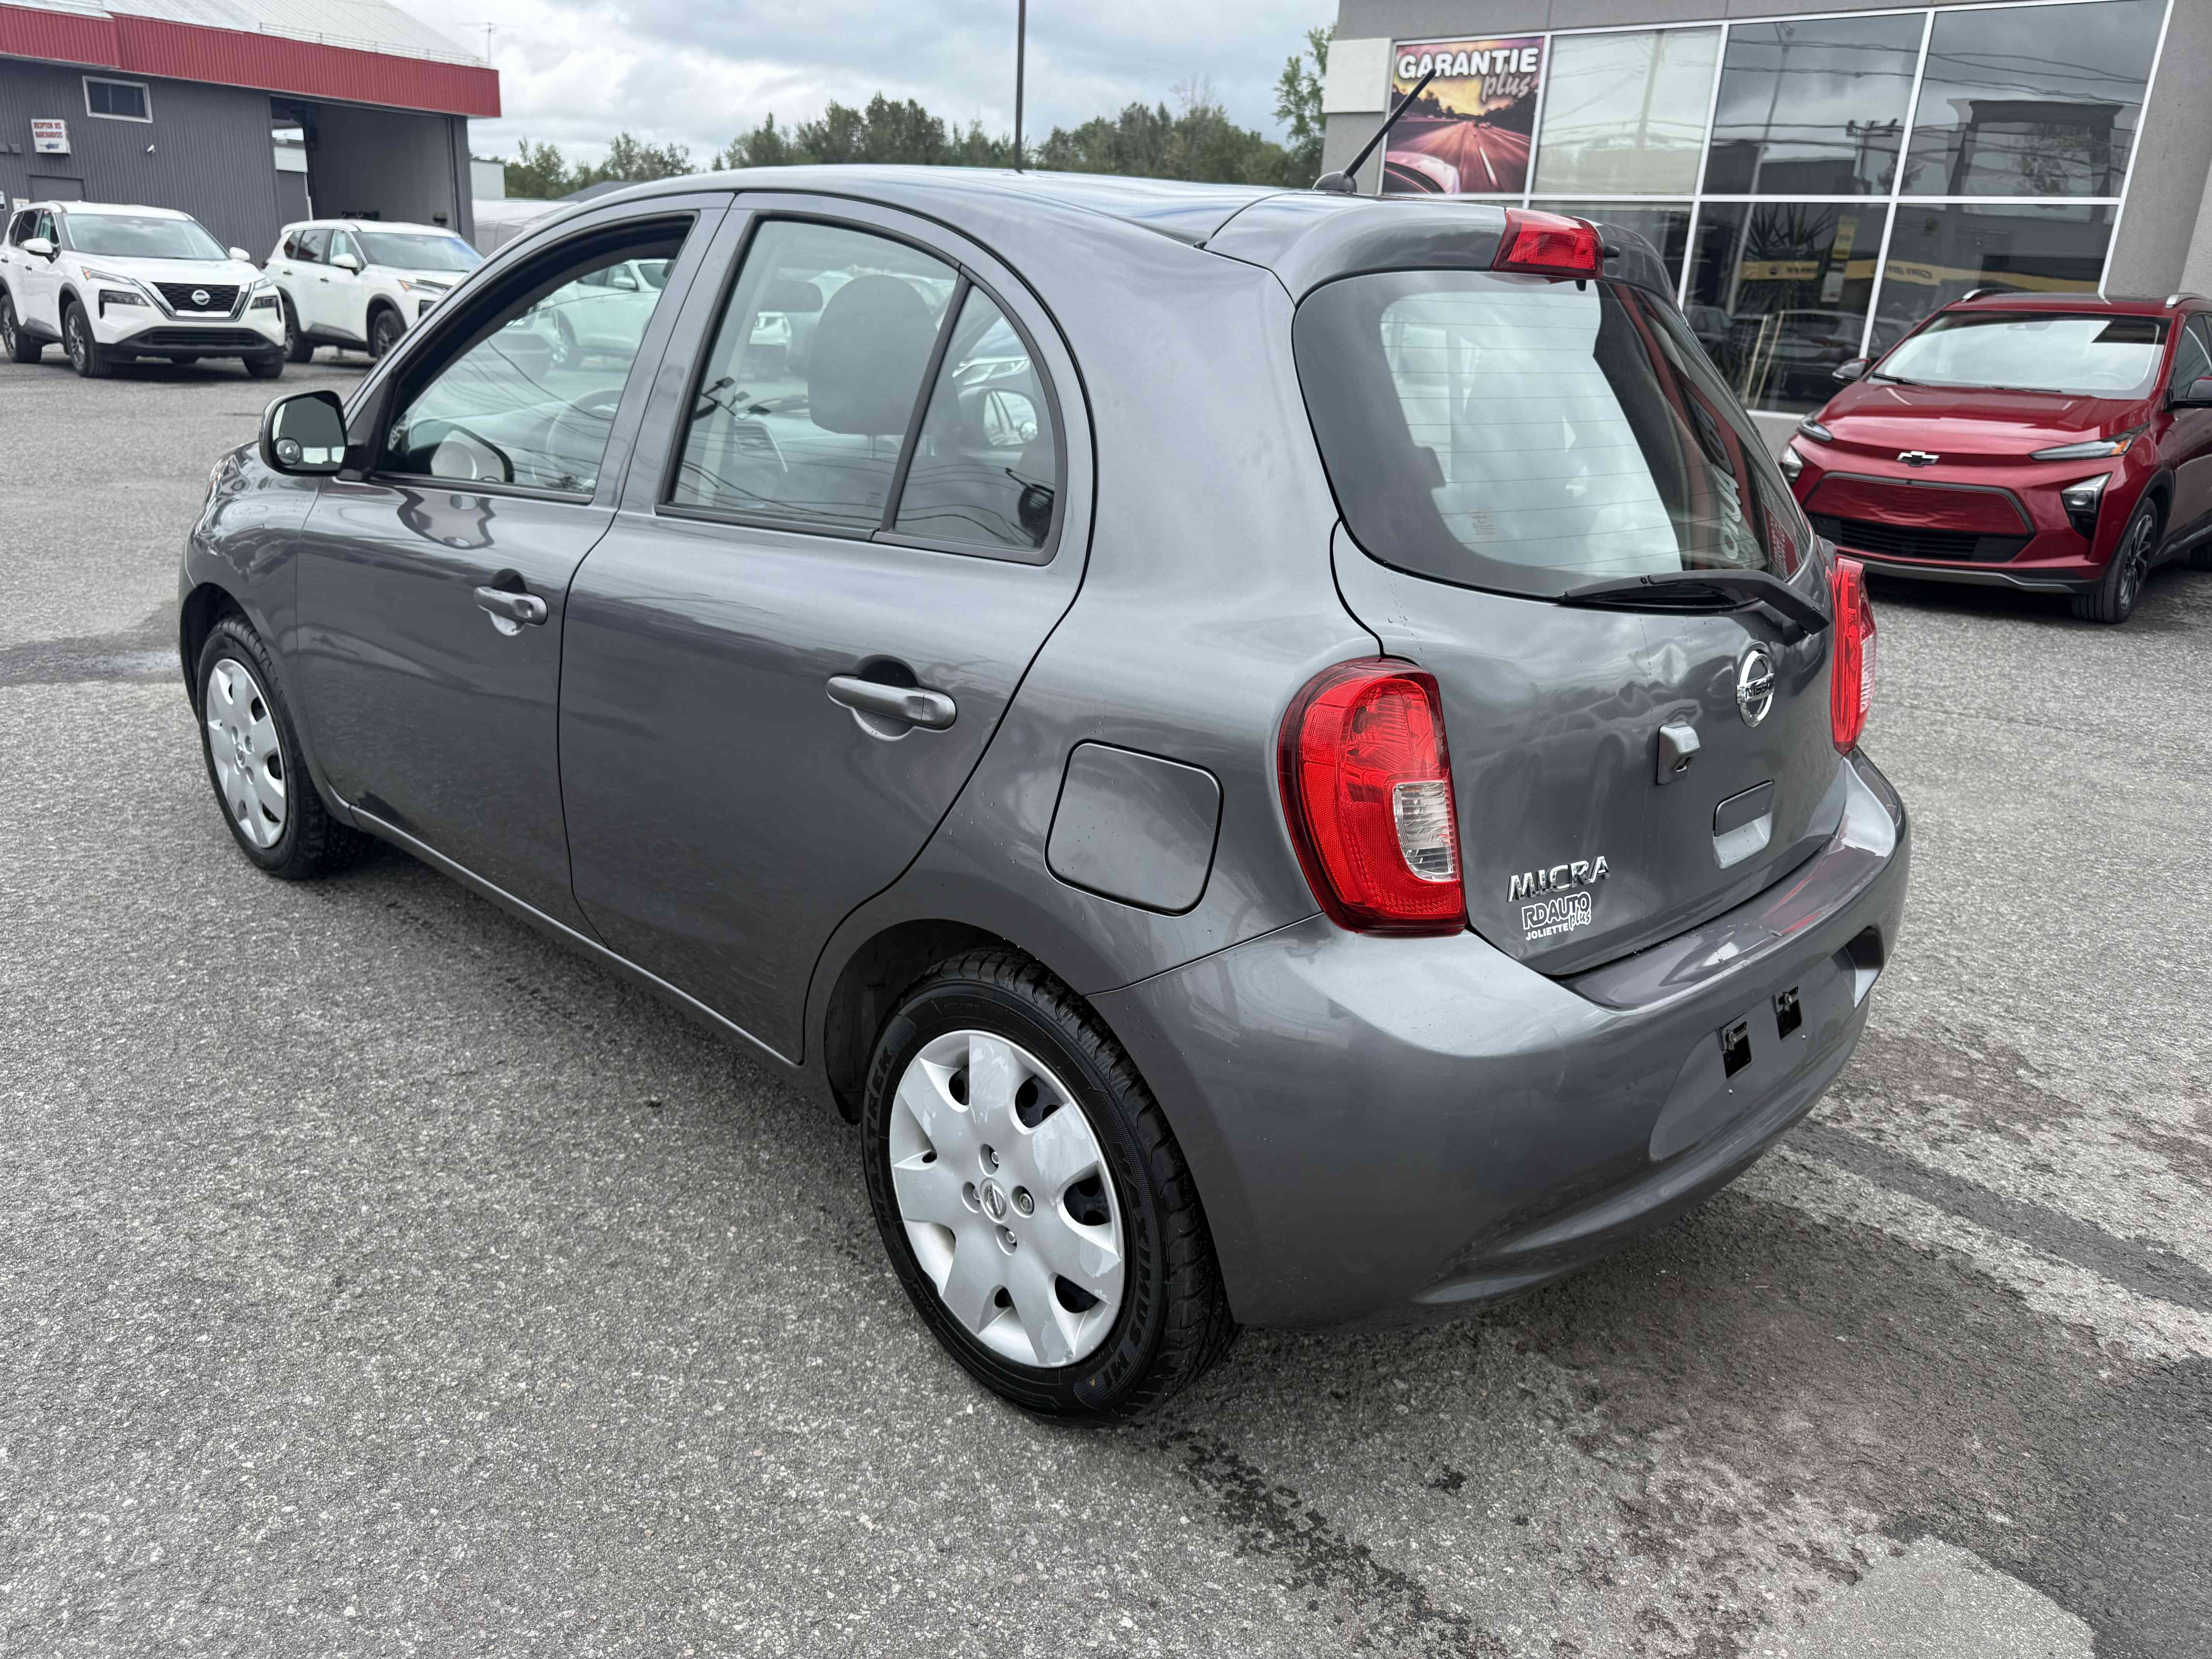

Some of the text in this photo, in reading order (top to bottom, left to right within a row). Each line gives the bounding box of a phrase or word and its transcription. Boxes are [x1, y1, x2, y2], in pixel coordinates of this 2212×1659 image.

[1397, 47, 1540, 79] GARANTIE
[1480, 65, 1532, 105] plus
[1507, 856, 1610, 902] MICRA
[1525, 922, 1569, 941] JOLIETTE
[1568, 904, 1591, 931] plus
